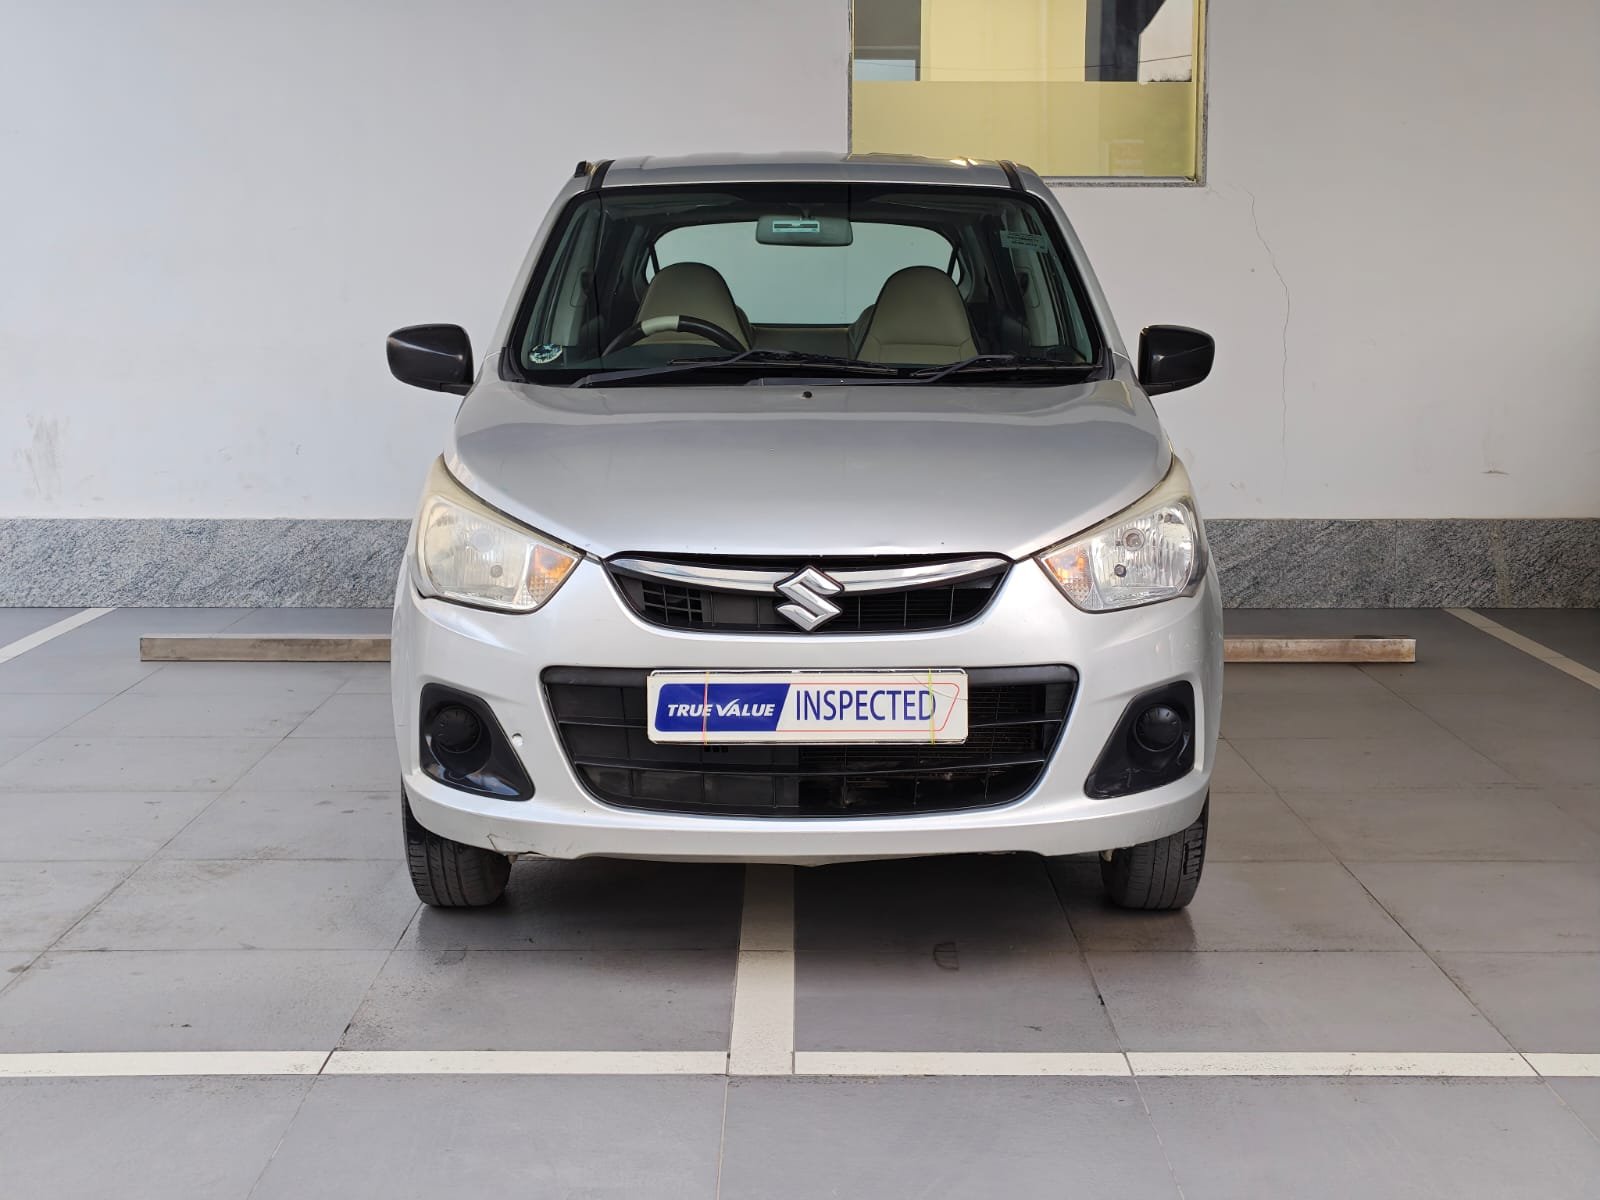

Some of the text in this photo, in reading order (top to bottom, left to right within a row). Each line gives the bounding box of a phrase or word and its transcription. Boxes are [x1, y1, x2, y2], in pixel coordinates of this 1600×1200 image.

[667, 698, 776, 717] TRUE VALUE
[796, 689, 936, 721] INSPECTED
